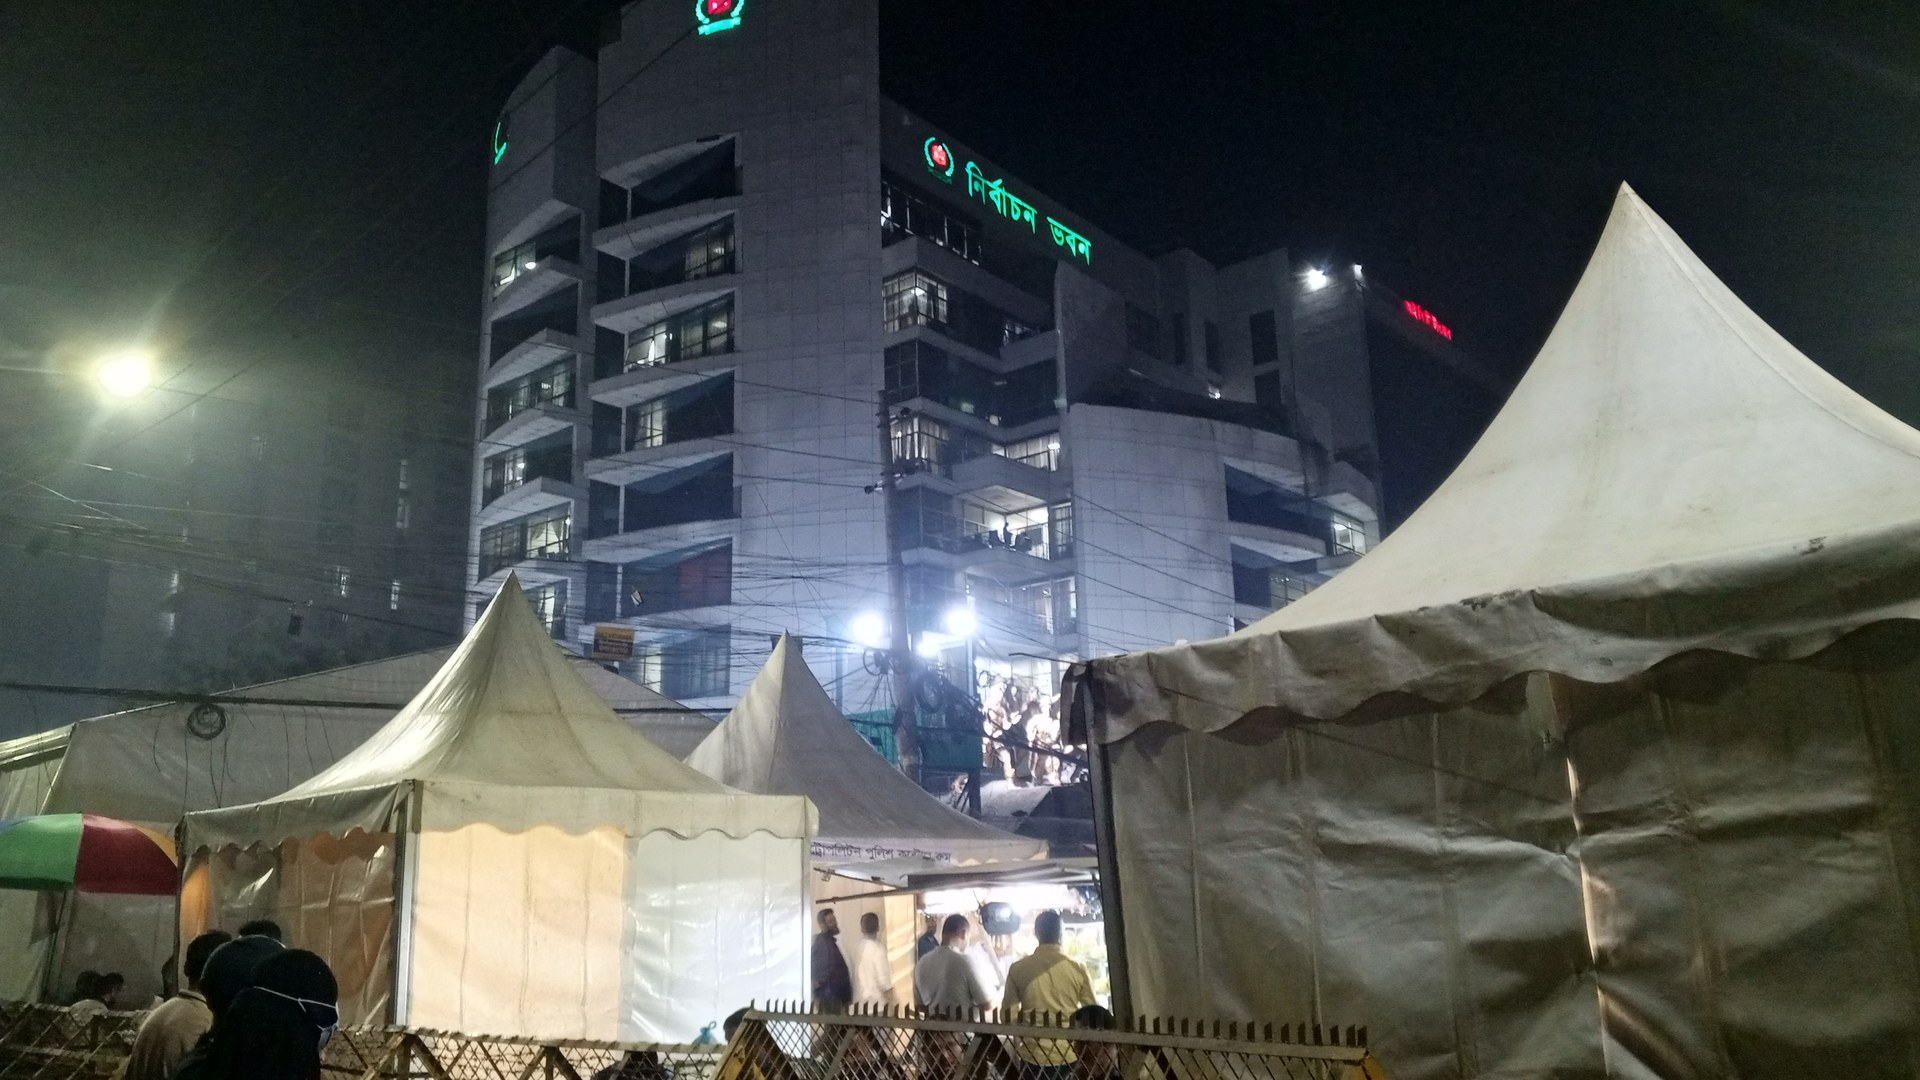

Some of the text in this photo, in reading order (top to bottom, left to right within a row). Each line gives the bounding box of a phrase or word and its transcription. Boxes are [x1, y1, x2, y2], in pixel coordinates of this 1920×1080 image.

[965, 160, 1092, 266] নির্বাচন ভবন
[865, 844, 894, 861] পুলিশ
